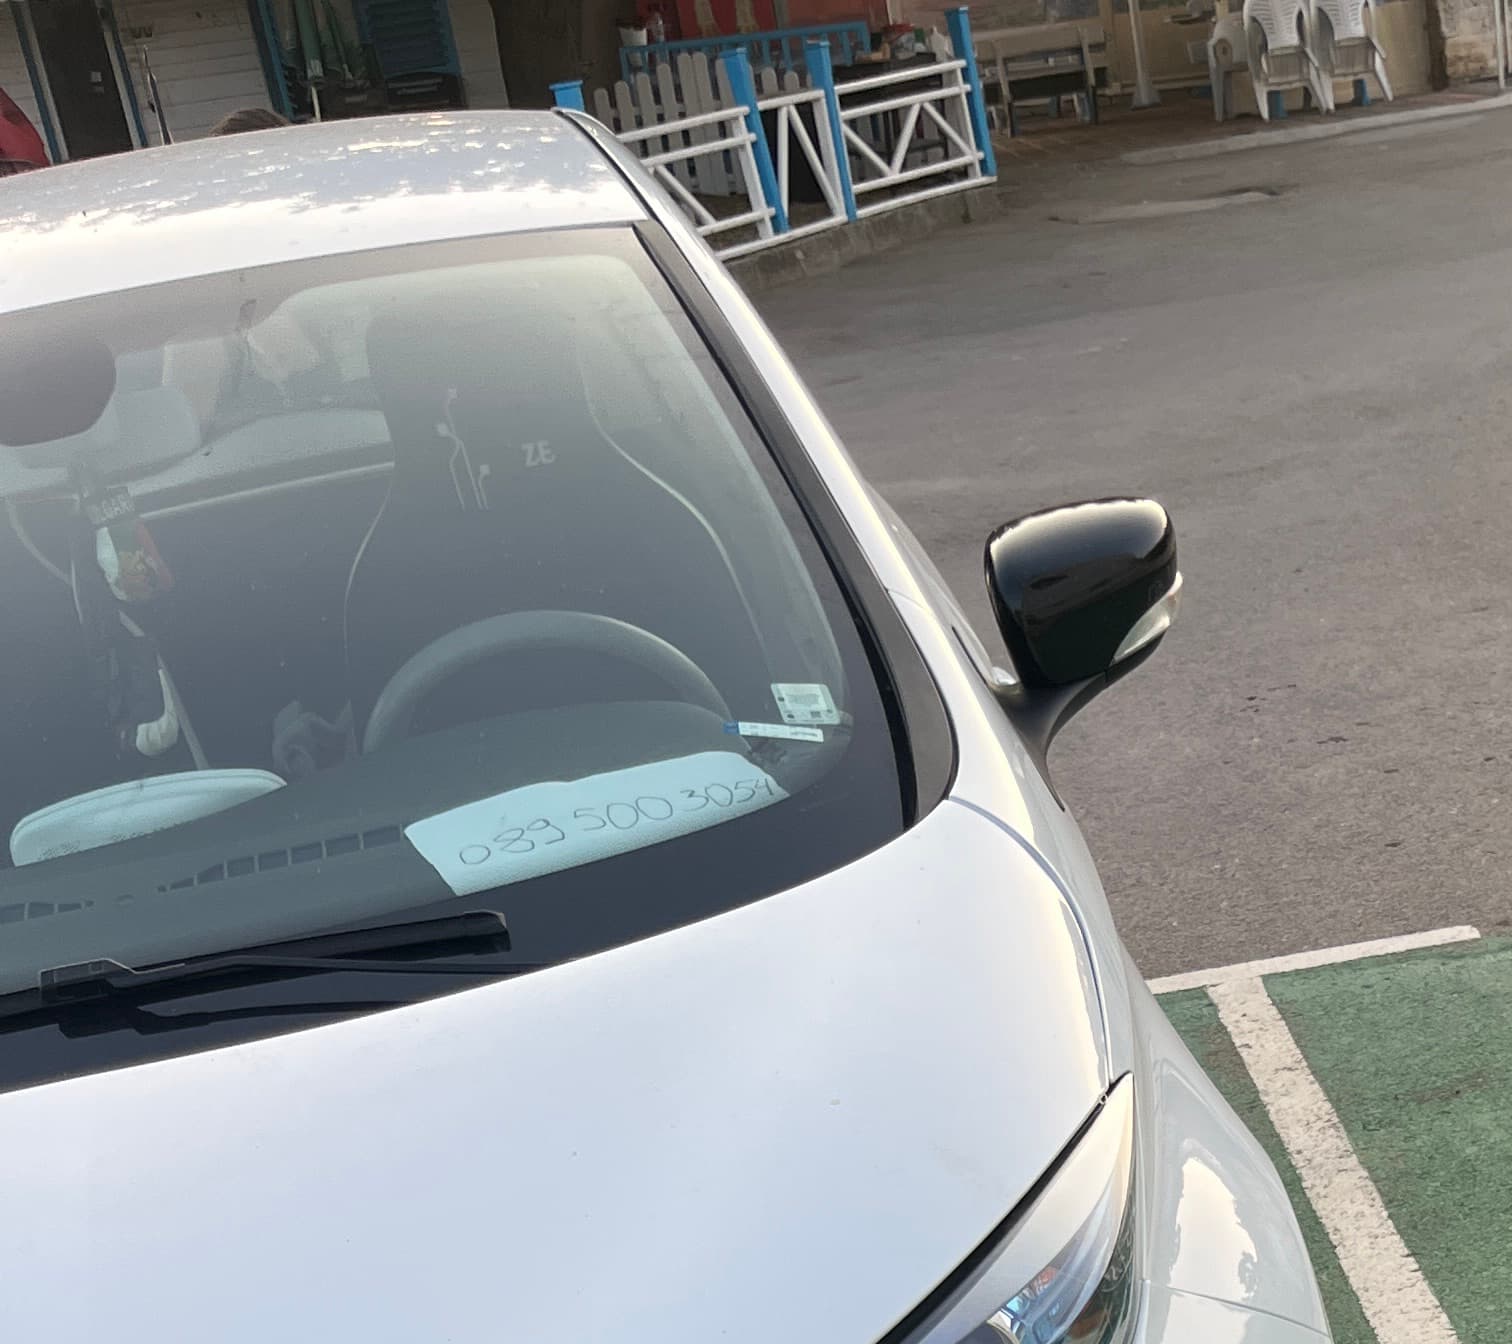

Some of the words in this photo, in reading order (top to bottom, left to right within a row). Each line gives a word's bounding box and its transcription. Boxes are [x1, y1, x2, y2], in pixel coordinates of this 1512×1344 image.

[521, 439, 556, 470] ZE
[459, 818, 565, 865] 089
[573, 795, 673, 830] 500
[679, 778, 774, 813] 3054
